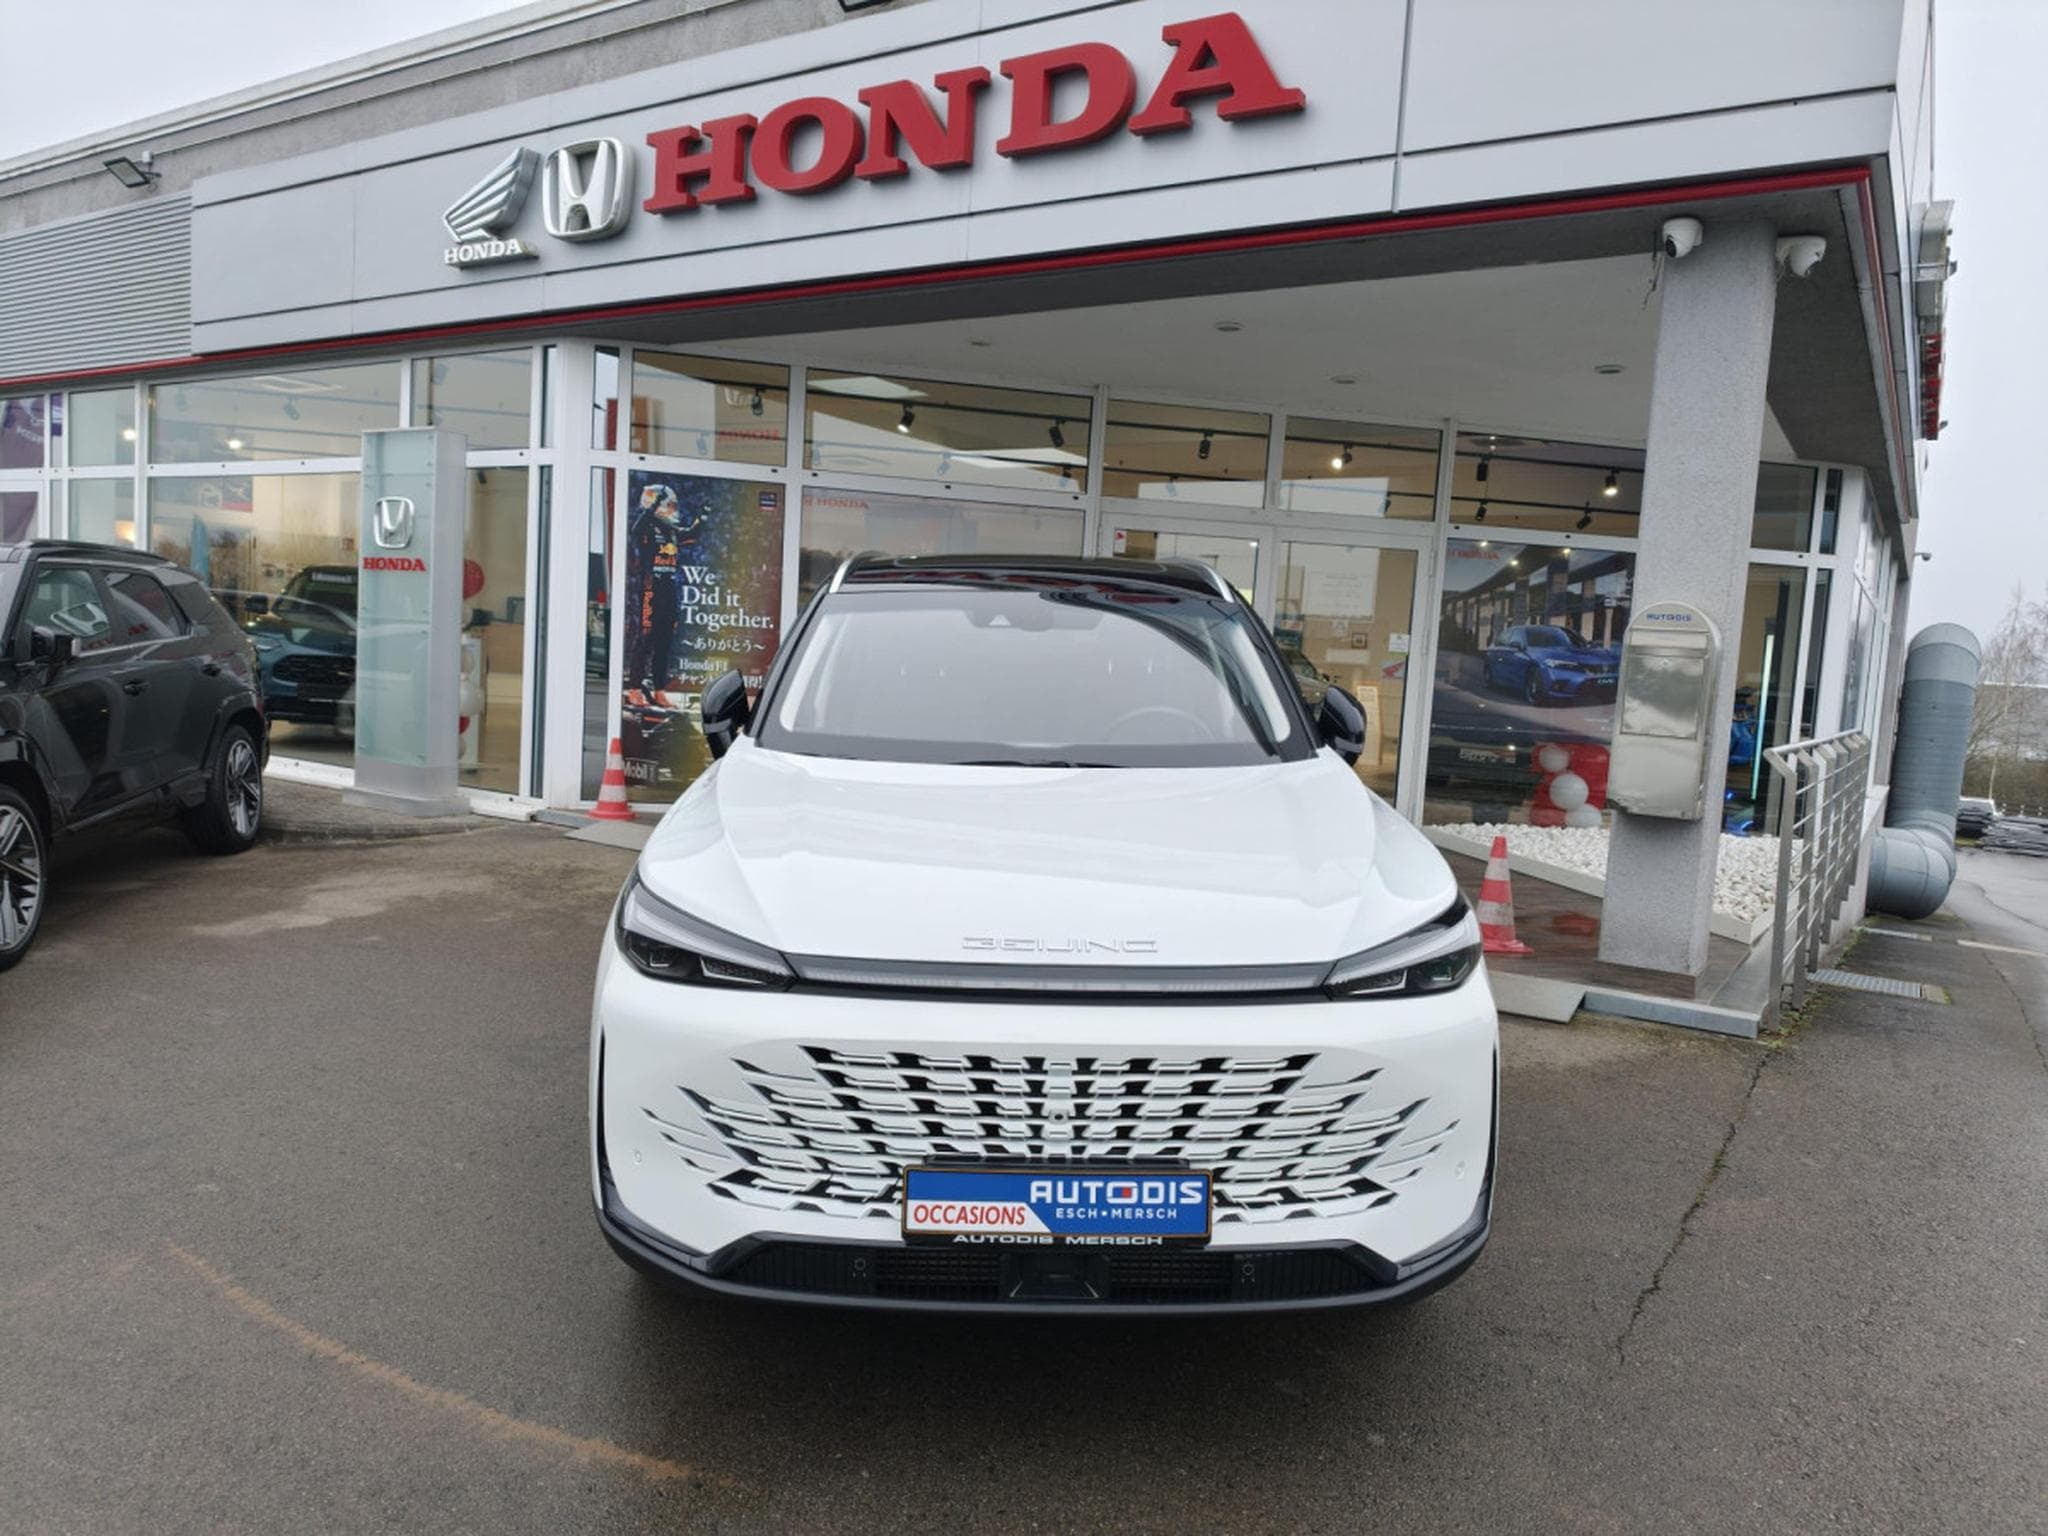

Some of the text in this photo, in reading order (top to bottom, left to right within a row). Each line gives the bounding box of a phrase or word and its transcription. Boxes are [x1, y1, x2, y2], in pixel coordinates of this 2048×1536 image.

[644, 12, 1305, 214] HONDA
[443, 238, 523, 265] HONDA
[363, 557, 426, 572] HONDA
[681, 565, 716, 585] We
[681, 585, 741, 607] Did it
[681, 606, 775, 633] Together.
[1646, 613, 1692, 622] AUTODIS
[679, 658, 713, 672] Honda
[1029, 1179, 1204, 1205] AUTODIS
[912, 1204, 1026, 1226] OCCASIONS
[952, 1233, 1164, 1246] AUTODIS MERSCH
